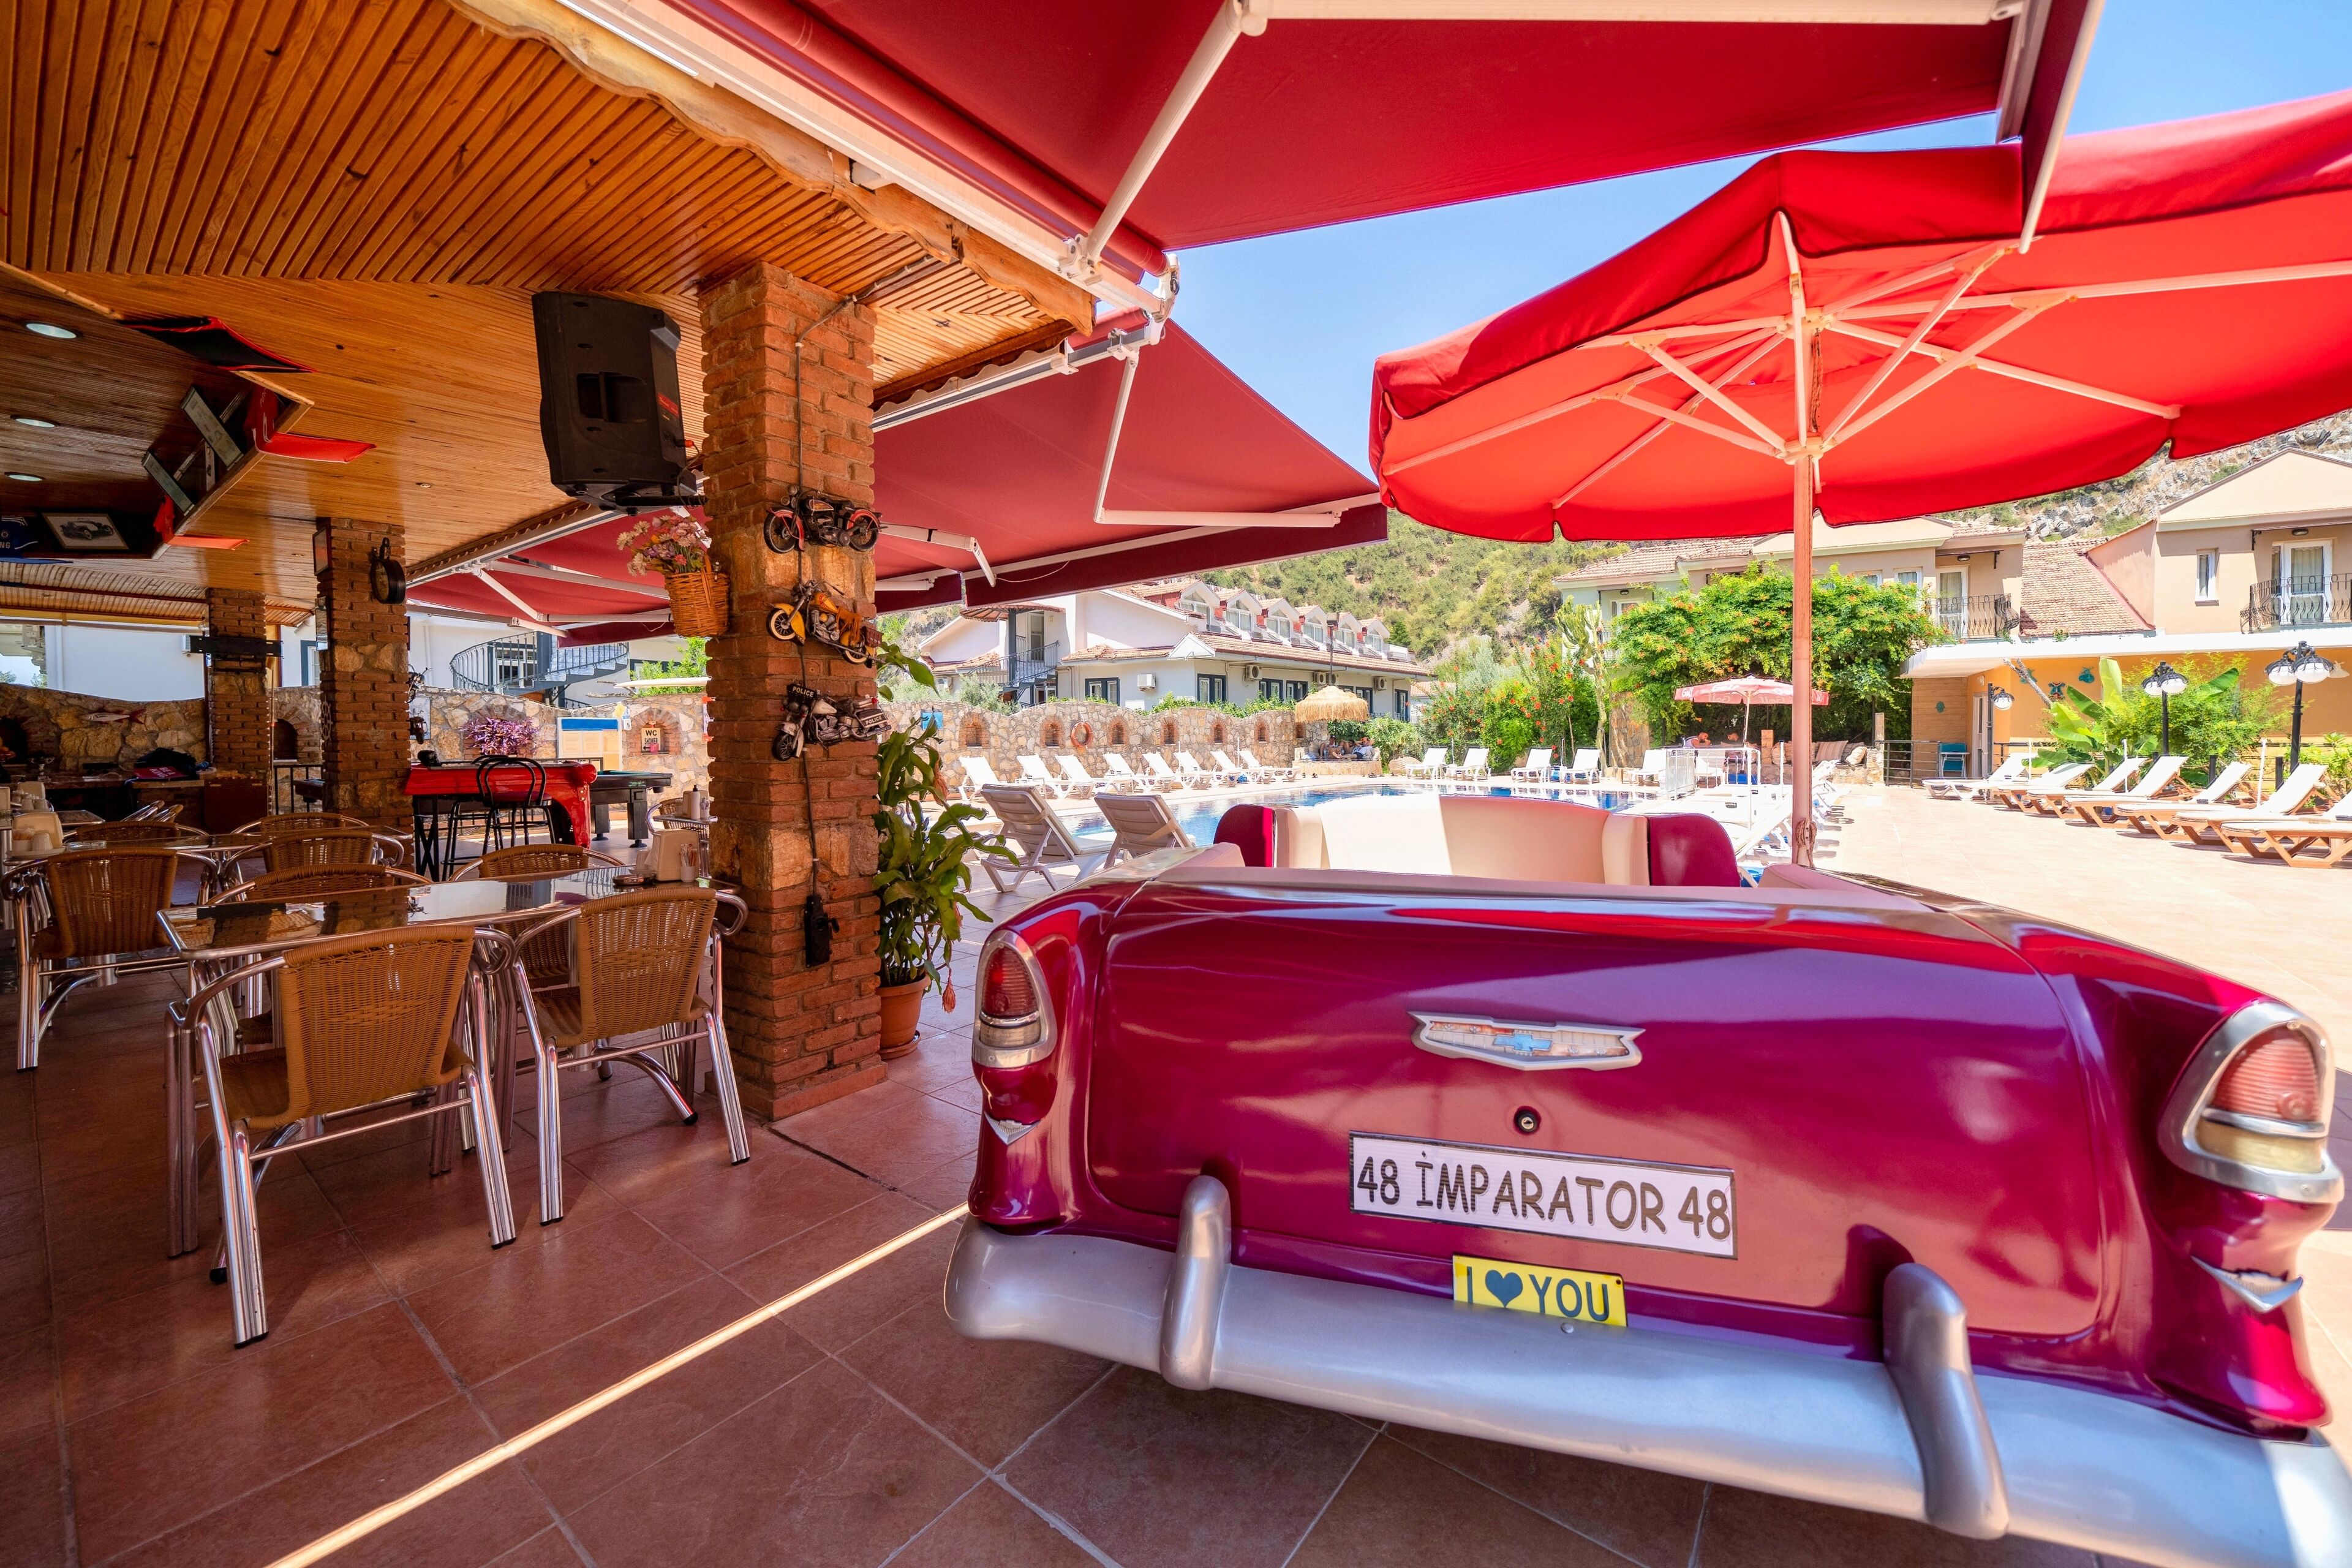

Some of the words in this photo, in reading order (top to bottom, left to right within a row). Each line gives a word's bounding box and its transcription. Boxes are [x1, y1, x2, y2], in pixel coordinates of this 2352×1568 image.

[793, 685, 815, 698] POLICE
[865, 715, 883, 725] POLICE
[1357, 1156, 1400, 1205] 48
[1415, 1150, 1667, 1234] İMPARATOR
[1678, 1186, 1730, 1240] 48
[1466, 1266, 1474, 1304] I
[1528, 1273, 1610, 1322] YOU
